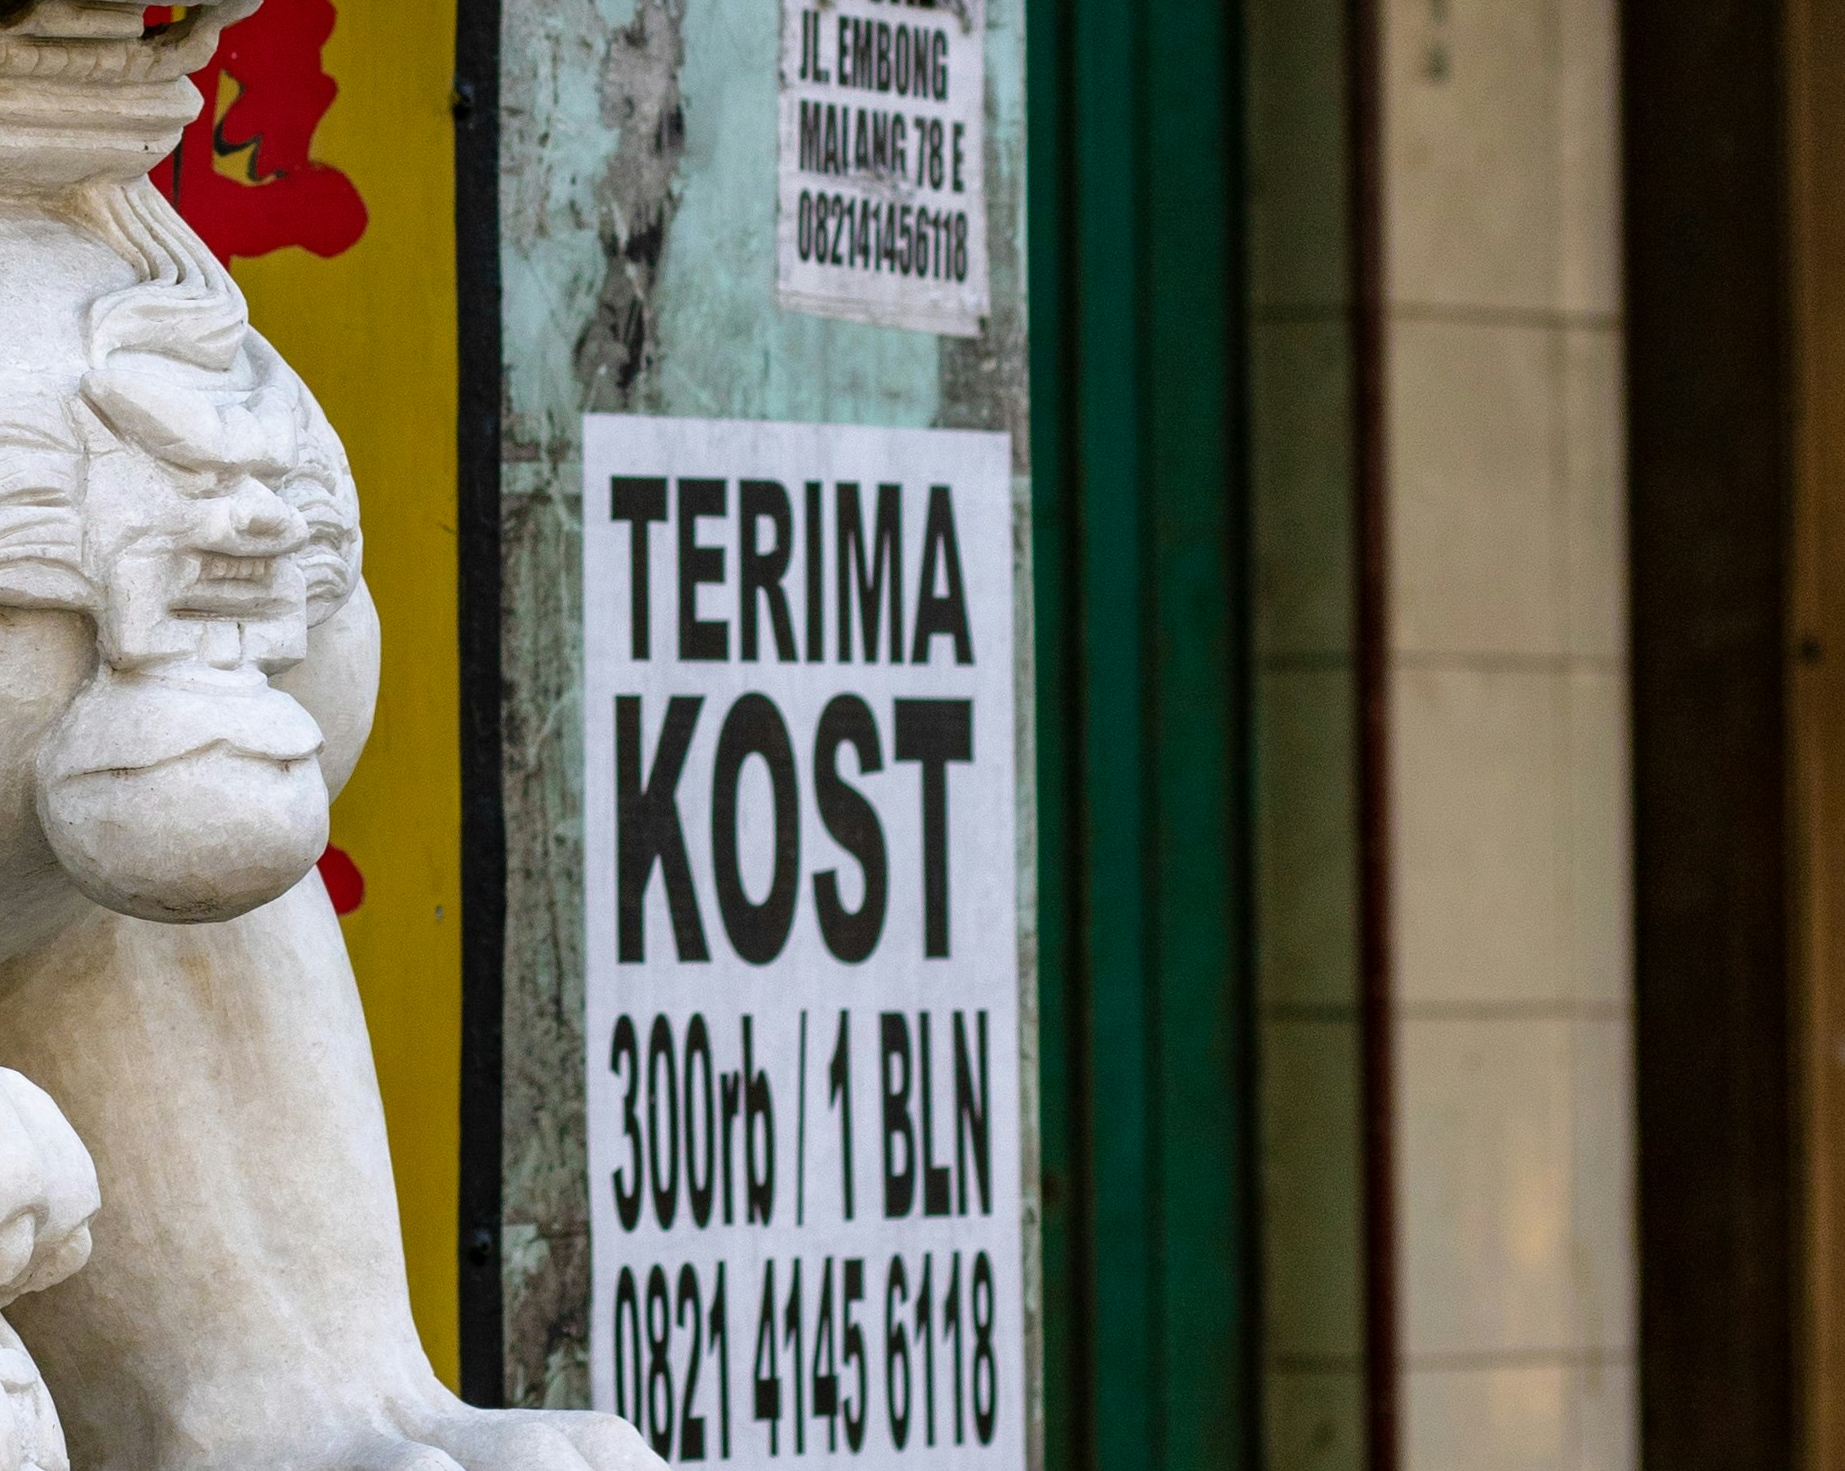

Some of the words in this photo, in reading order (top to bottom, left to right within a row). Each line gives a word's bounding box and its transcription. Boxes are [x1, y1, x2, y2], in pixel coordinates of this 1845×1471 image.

[799, 9, 830, 84] JL.
[837, 14, 950, 103] EMBONG
[799, 98, 908, 180] MALANG
[914, 115, 944, 192] 78
[952, 121, 965, 194] E
[797, 189, 969, 285] 082141456118
[610, 475, 974, 665] TERIMA
[614, 692, 975, 965] KOST
[610, 1012, 776, 1233] 300rb
[829, 1009, 854, 1222] 1
[879, 1009, 993, 1221] BLN
[614, 1259, 731, 1463] 0821
[752, 1256, 868, 1458] 4145
[884, 1249, 999, 1453] 6118
